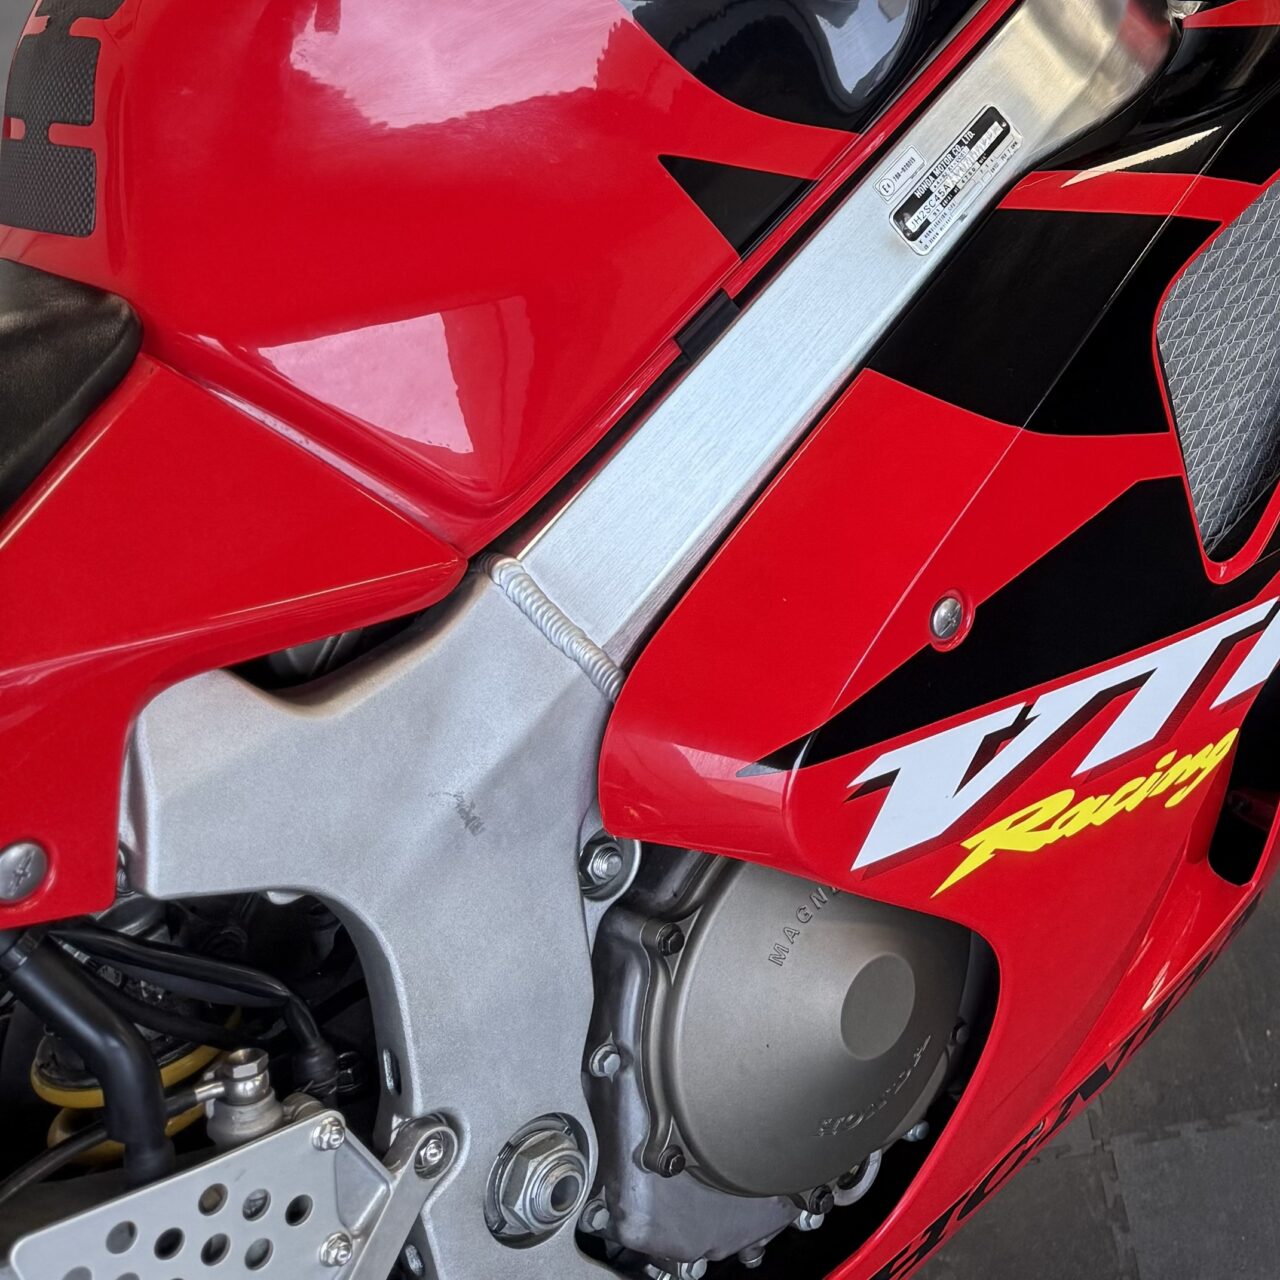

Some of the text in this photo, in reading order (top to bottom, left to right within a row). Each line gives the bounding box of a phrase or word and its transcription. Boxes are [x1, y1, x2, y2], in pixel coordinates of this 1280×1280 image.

[913, 175, 937, 199] HONDA
[932, 153, 954, 177] MOTOR
[930, 727, 1240, 898] Racing
[768, 886, 841, 966] MAGN
